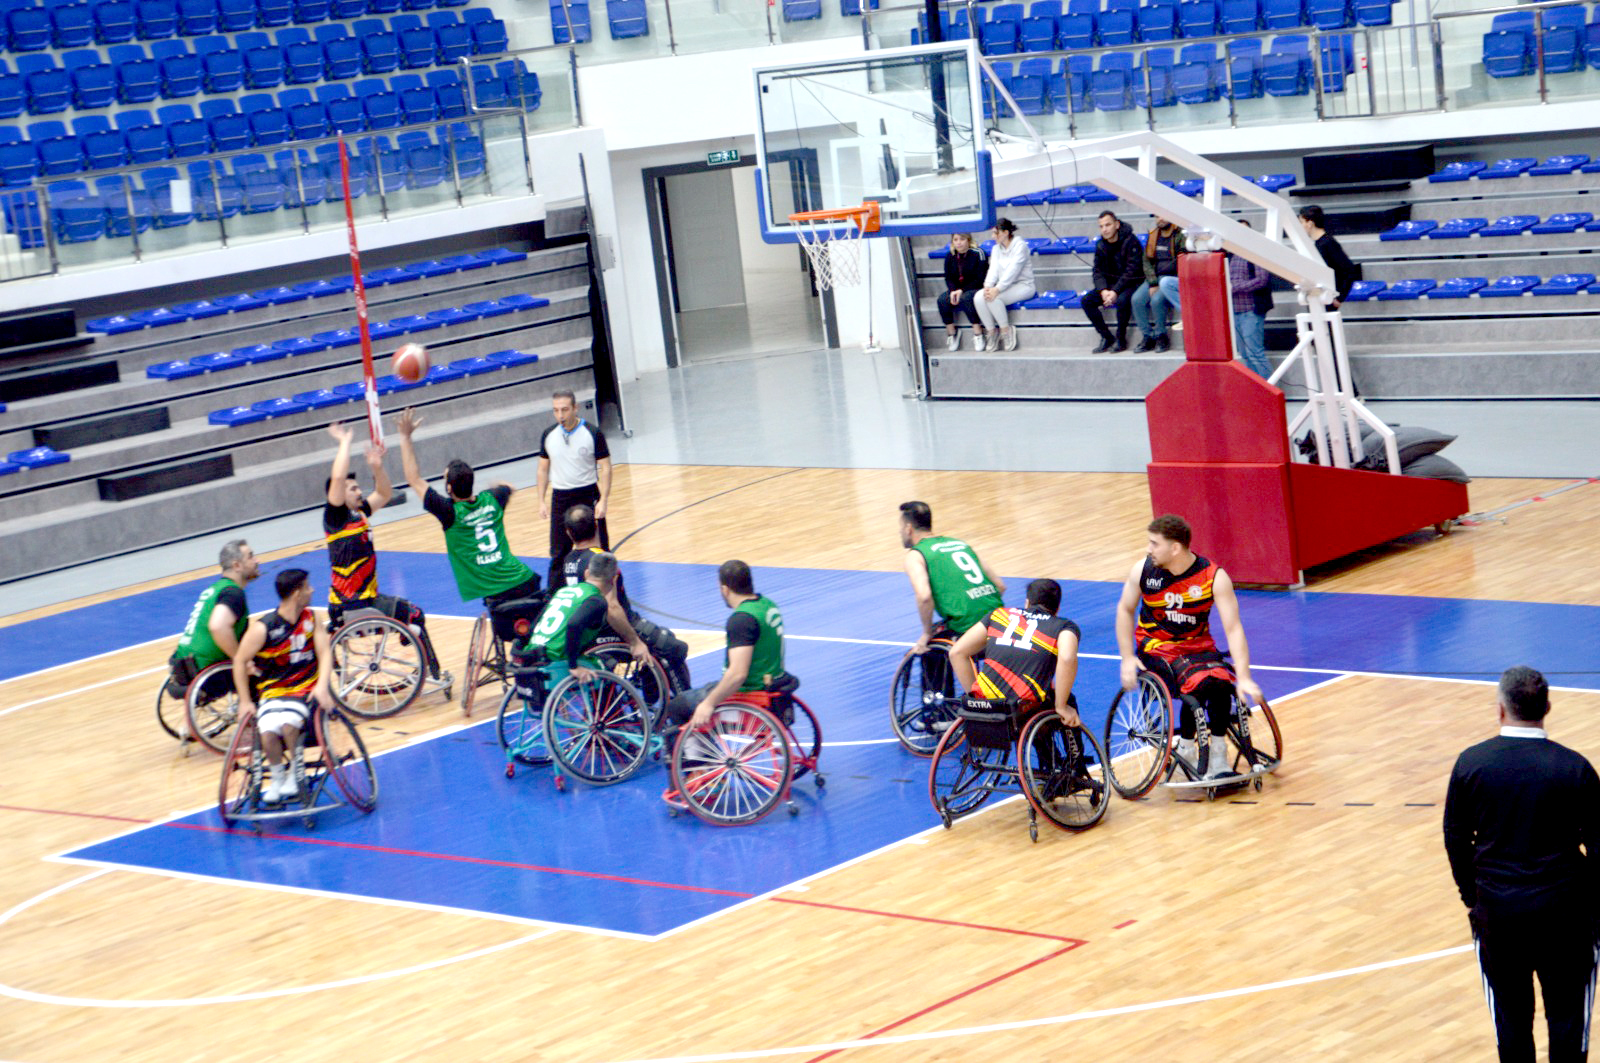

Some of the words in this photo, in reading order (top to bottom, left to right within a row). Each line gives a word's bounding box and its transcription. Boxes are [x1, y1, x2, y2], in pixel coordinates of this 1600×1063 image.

[475, 521, 498, 552] 5
[951, 551, 984, 584] 9
[1164, 592, 1184, 609] 99
[995, 614, 1038, 650] 11
[967, 700, 992, 709] EXTRA
